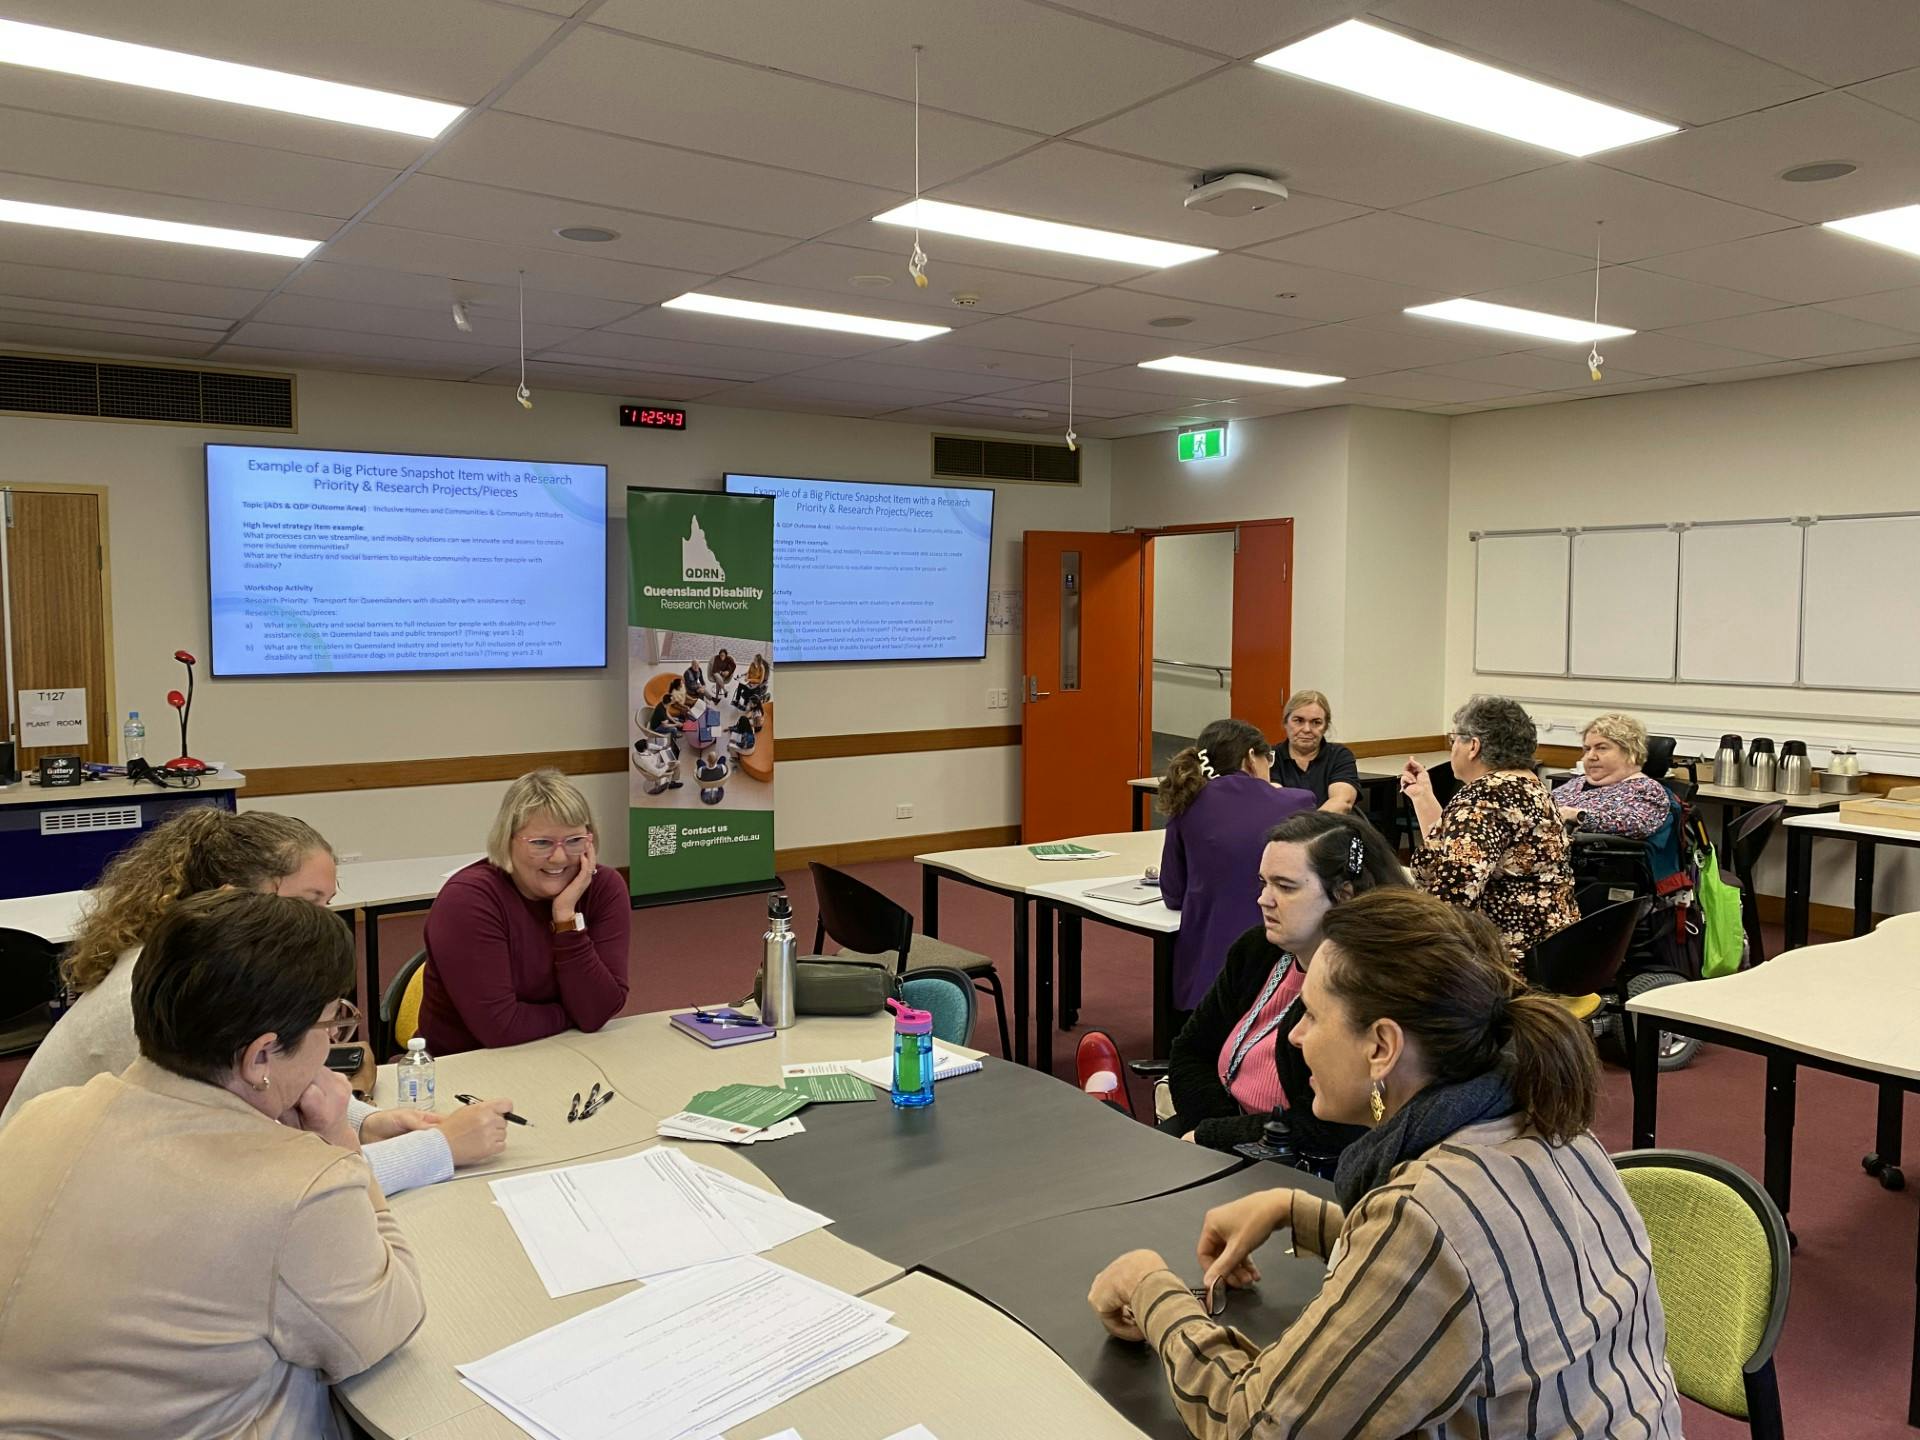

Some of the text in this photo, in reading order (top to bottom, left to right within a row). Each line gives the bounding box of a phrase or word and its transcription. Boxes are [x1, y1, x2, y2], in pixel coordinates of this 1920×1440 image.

[248, 459, 573, 486] Example of a Big Picture Snapshot Item with a Research
[314, 479, 519, 499] Priority & Research Projects/Pieces
[792, 489, 802, 499] of
[810, 490, 824, 501] Big
[825, 491, 854, 502] Picture
[855, 492, 892, 505] Snapshot
[894, 495, 911, 504] Item
[913, 495, 930, 506] with
[938, 497, 971, 508] Research
[796, 502, 934, 518] Priority & Research Projects/Pieces
[643, 585, 764, 600] Queensland Disability
[660, 598, 750, 610] Research Network
[37, 691, 65, 702] T127
[56, 719, 82, 728] ROOM
[682, 825, 717, 836] Contact
[681, 834, 760, 848] qdrn@griffith.edu.au
